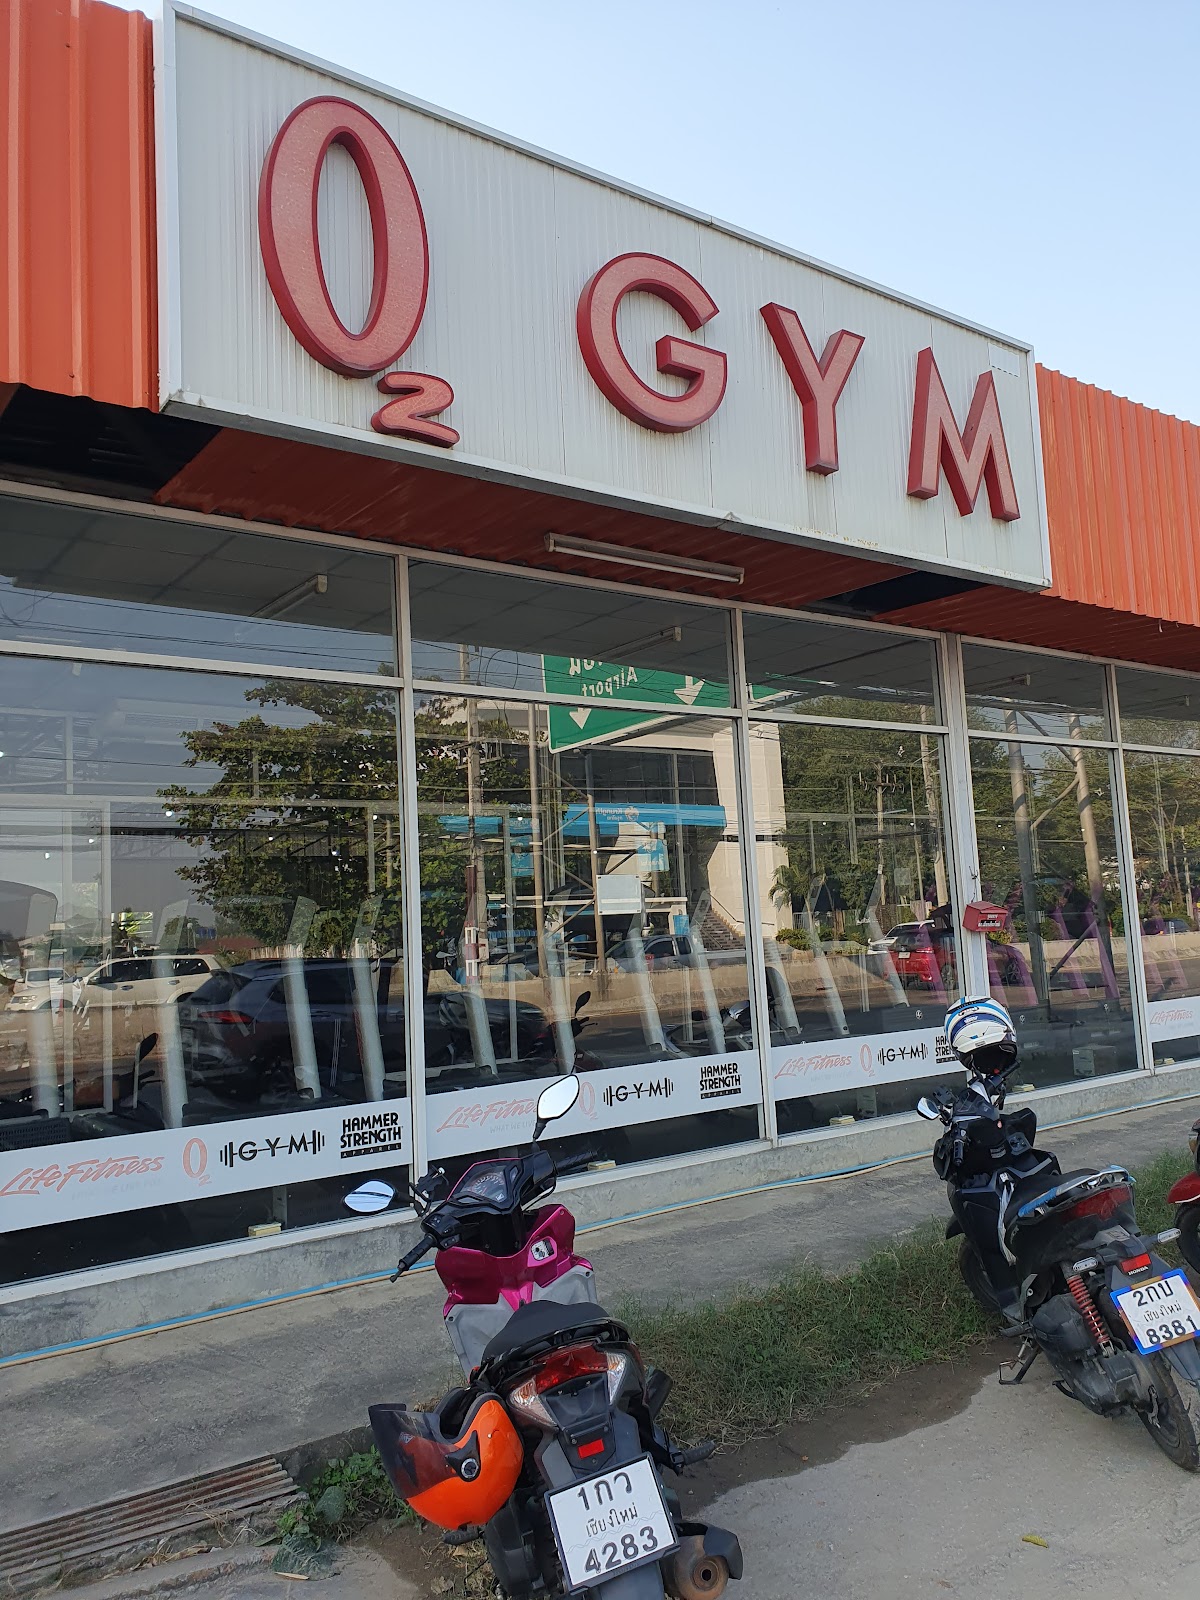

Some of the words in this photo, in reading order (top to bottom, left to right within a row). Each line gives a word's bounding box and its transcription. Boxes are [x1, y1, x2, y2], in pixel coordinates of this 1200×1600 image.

[577, 251, 1021, 522] GYM
[935, 1046, 950, 1057] STRE
[700, 1062, 738, 1079] HAMMER
[699, 1074, 741, 1092] STRENGTH
[342, 1112, 399, 1134] HAMMER
[236, 1131, 308, 1162] GYM
[340, 1126, 401, 1149] STRENGTH
[342, 1144, 400, 1157] APPAREL
[1128, 1266, 1149, 1276] HONDA
[1146, 1315, 1198, 1345] 8381
[577, 1471, 633, 1511] 1กว
[585, 1502, 639, 1538] เชียงใหม่
[584, 1525, 659, 1574] 4283
